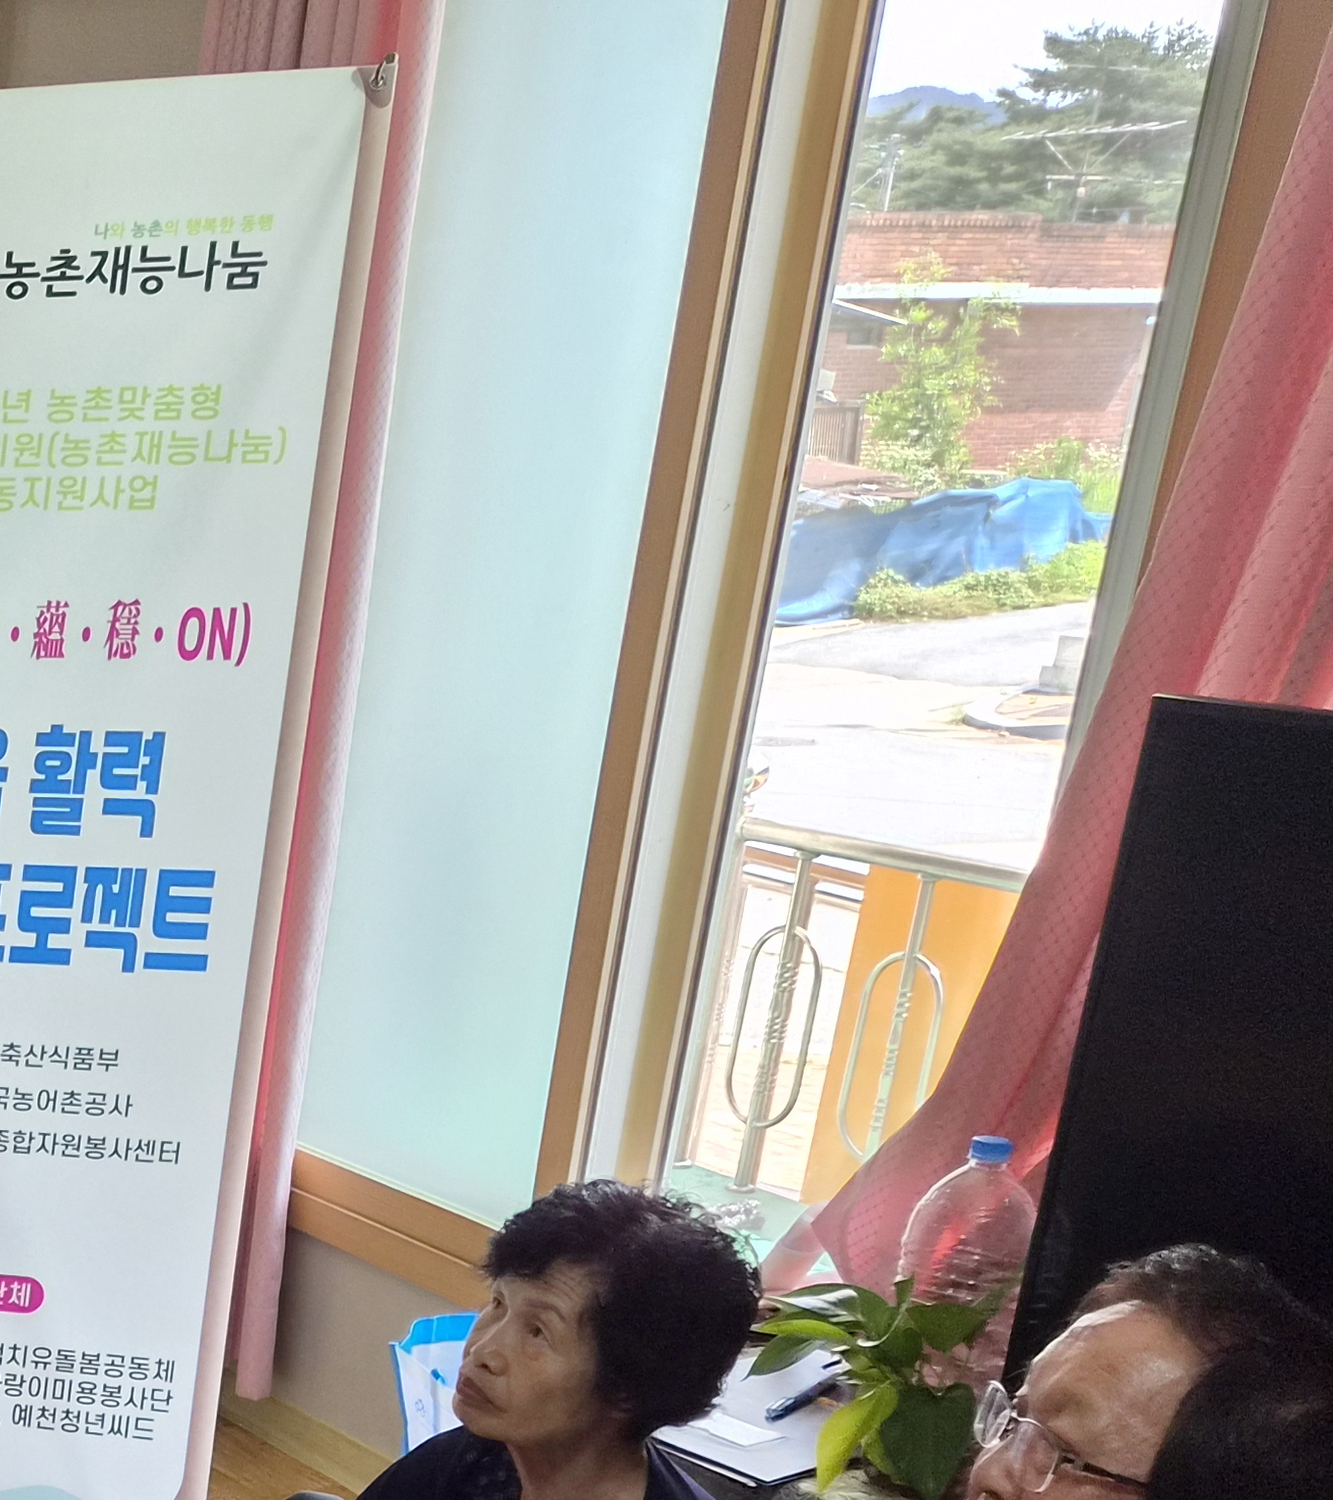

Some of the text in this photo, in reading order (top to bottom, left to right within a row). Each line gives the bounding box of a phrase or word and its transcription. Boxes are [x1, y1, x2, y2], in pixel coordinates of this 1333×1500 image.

[94, 220, 126, 239] 나와
[130, 218, 179, 239] 농촌의
[46, 383, 223, 424] 농촌맞춤형
[29, 724, 167, 838] 활력
[11, 1404, 155, 1442] 예천청년씨드
